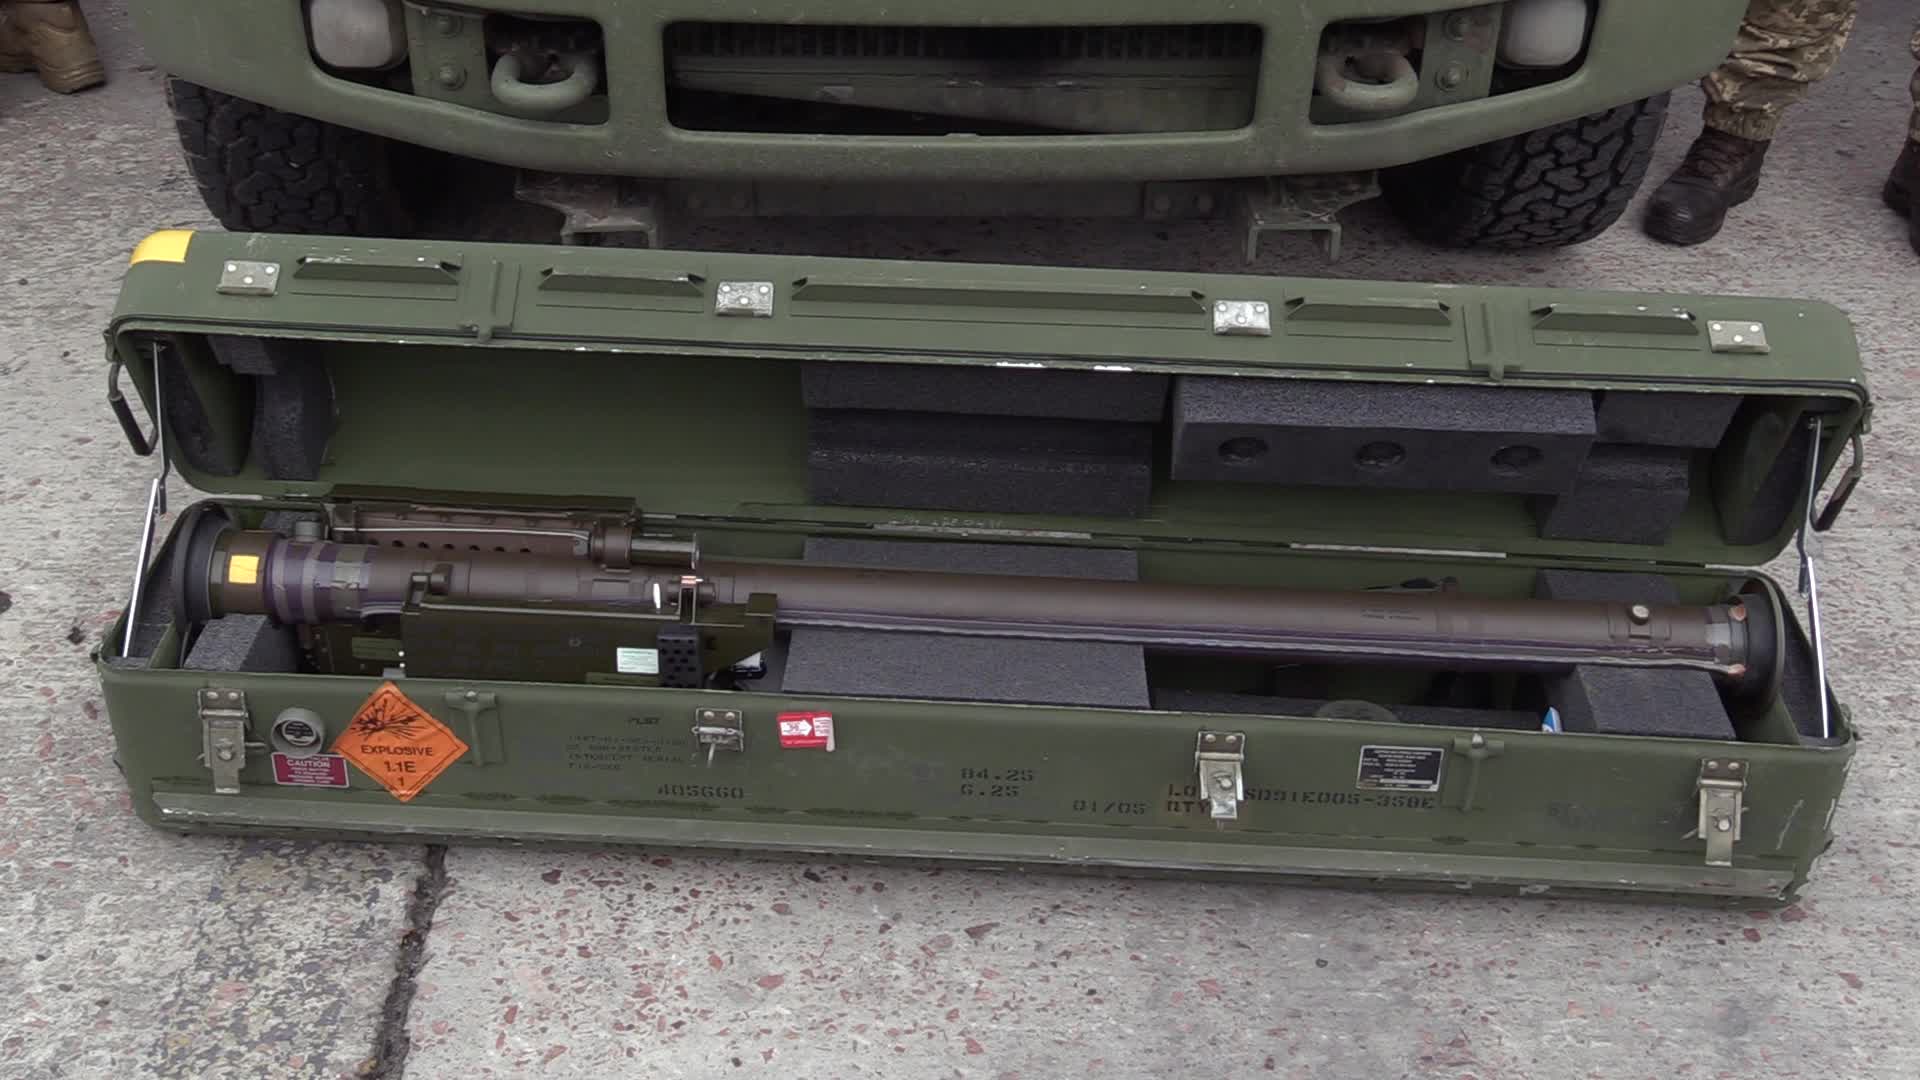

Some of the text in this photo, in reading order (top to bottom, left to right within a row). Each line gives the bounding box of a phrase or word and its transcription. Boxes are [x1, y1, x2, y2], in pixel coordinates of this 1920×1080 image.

[361, 744, 434, 757] EXPLOSIVE
[287, 759, 331, 768] CAUTION
[384, 760, 417, 774] 1.1E
[397, 775, 405, 787] 1
[657, 783, 744, 799] 405660
[1072, 799, 1147, 815] 01/05
